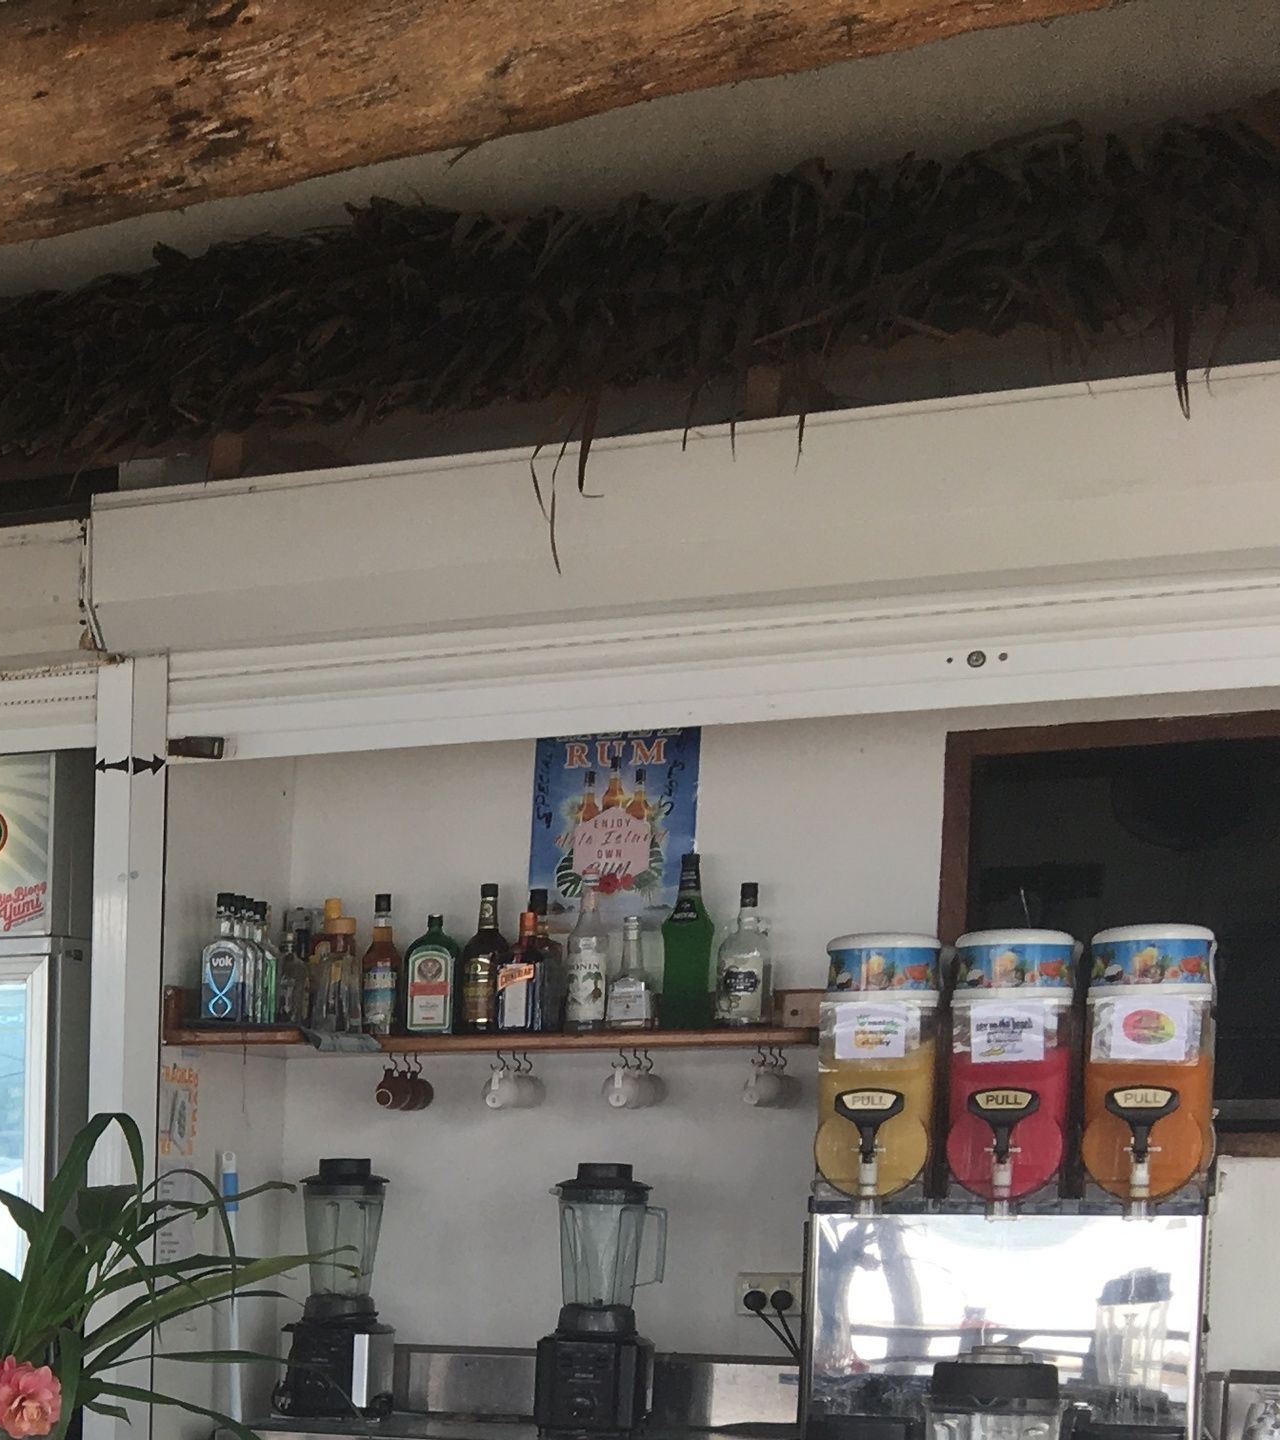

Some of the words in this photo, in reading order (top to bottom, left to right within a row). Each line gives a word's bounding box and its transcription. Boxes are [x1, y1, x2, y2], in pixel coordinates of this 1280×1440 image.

[564, 738, 668, 769] RUM
[593, 817, 632, 829] ENJOY
[596, 849, 623, 860] OWN
[568, 962, 601, 971] ONIN
[851, 1095, 887, 1106] PULL
[985, 1094, 1023, 1106] PULL
[1123, 1093, 1162, 1104] PULL
